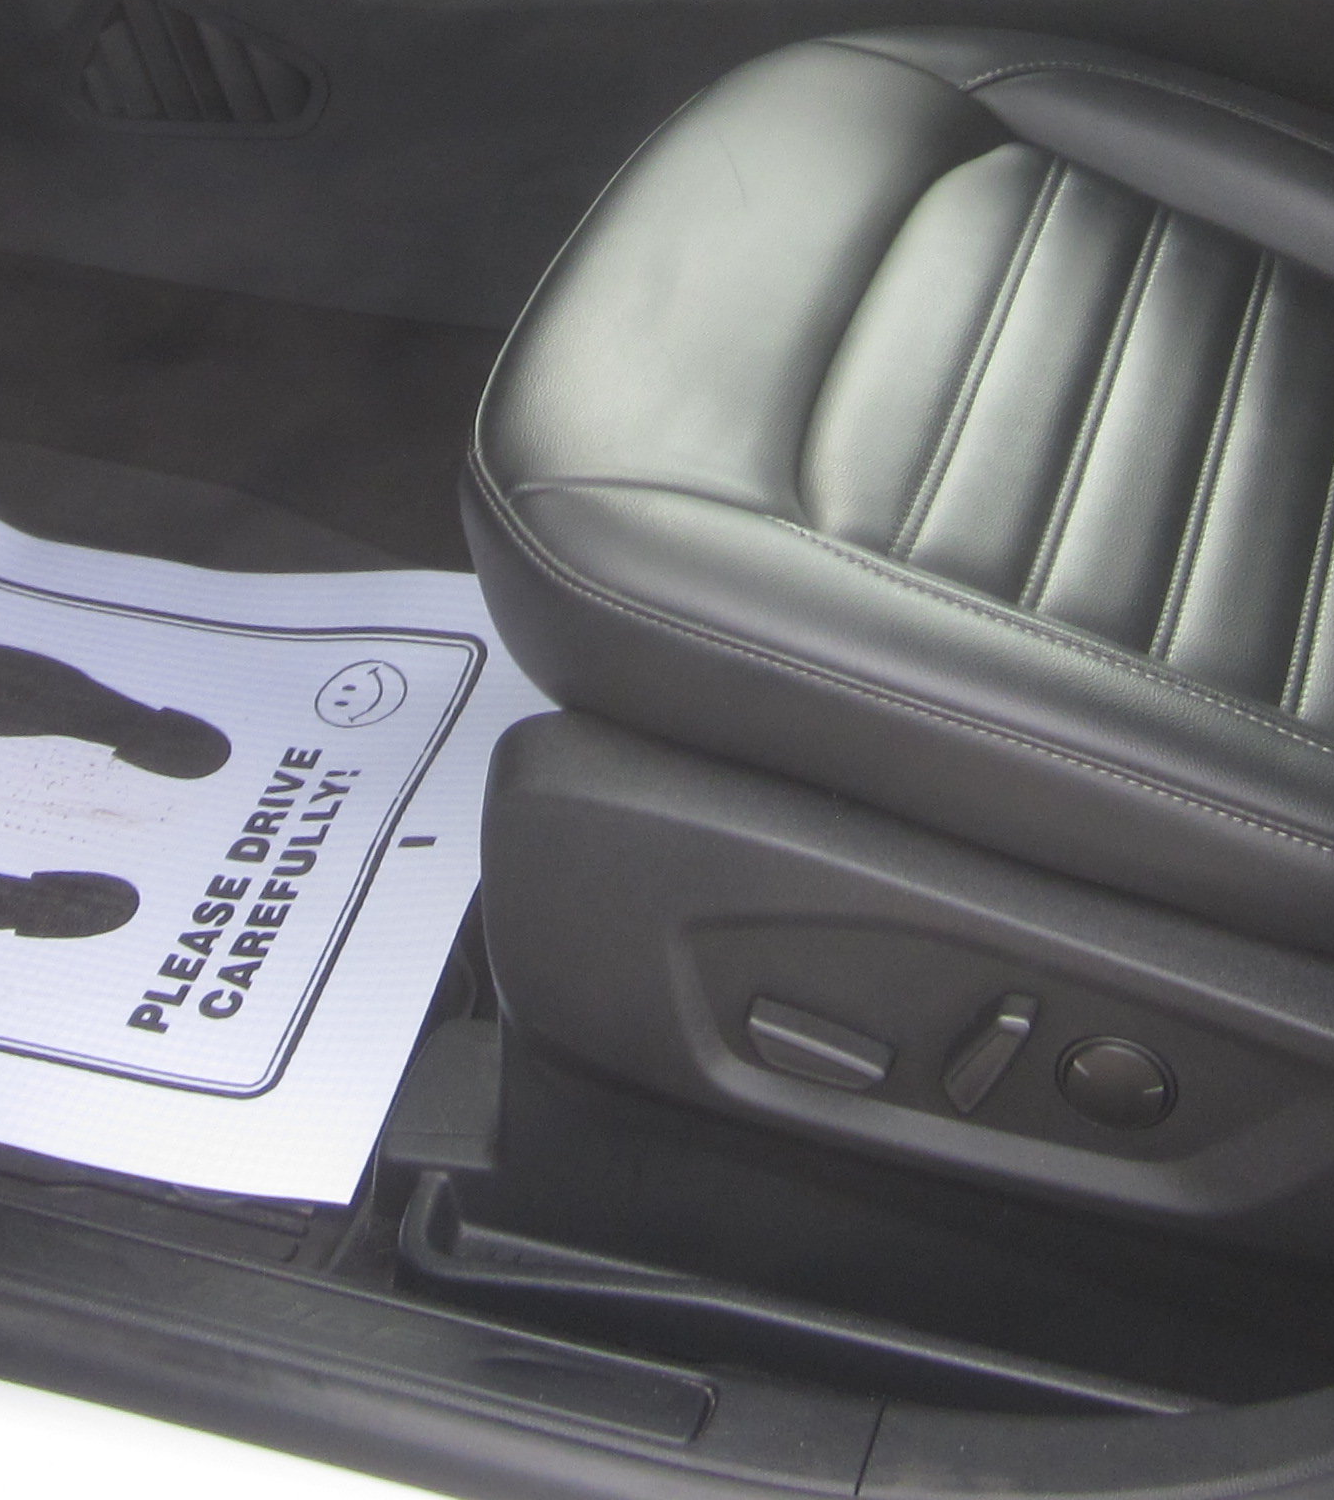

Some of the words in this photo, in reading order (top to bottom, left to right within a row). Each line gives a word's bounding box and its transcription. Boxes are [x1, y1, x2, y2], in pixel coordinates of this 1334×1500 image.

[126, 874, 252, 1034] PLEASE
[225, 747, 323, 863] DRIVE
[198, 769, 362, 1020] CAREFULLY!
